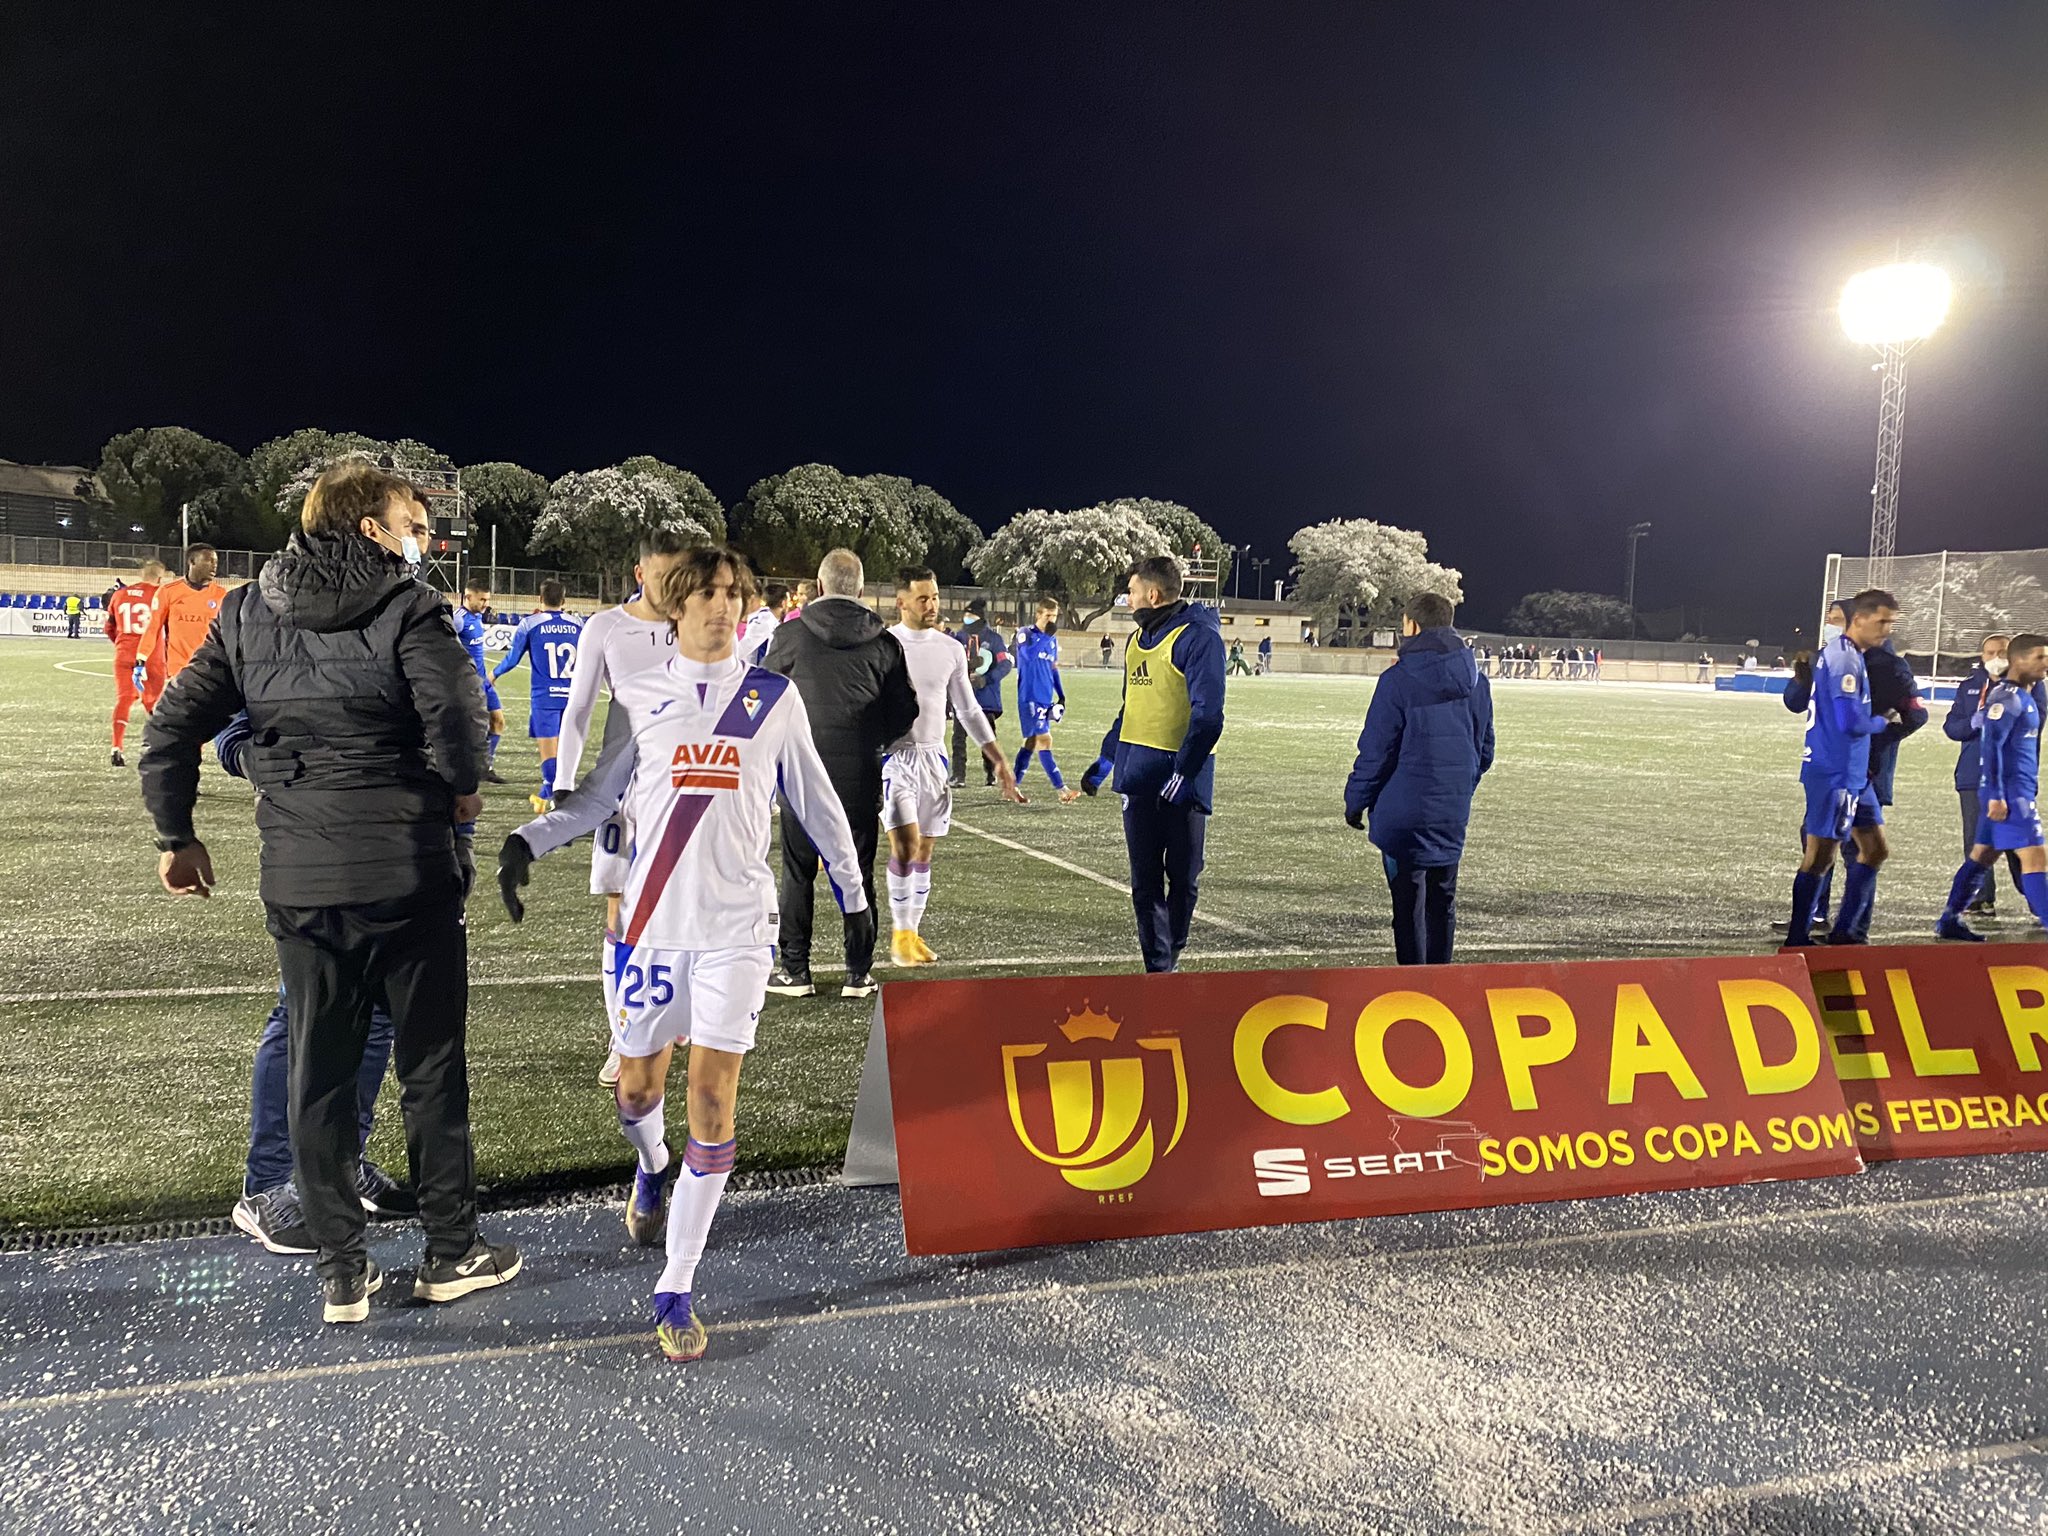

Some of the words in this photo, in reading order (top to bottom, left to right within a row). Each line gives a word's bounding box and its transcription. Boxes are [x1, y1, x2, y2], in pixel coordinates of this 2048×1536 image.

[118, 602, 151, 635] 13
[540, 624, 577, 635] AUGUSTO
[543, 642, 577, 679] 12
[1129, 675, 1153, 686] adidas
[624, 964, 674, 1009] 25
[1233, 983, 1708, 1126] COPA
[1718, 967, 1981, 1096] DEL
[1987, 965, 2048, 1073] R
[1478, 1128, 1636, 1176] SOMOS
[1645, 1120, 1762, 1163] COPA
[1772, 1102, 1881, 1154] SOMS
[1323, 1149, 1453, 1179] SEAT
[1097, 1192, 1135, 1205] RFEF
